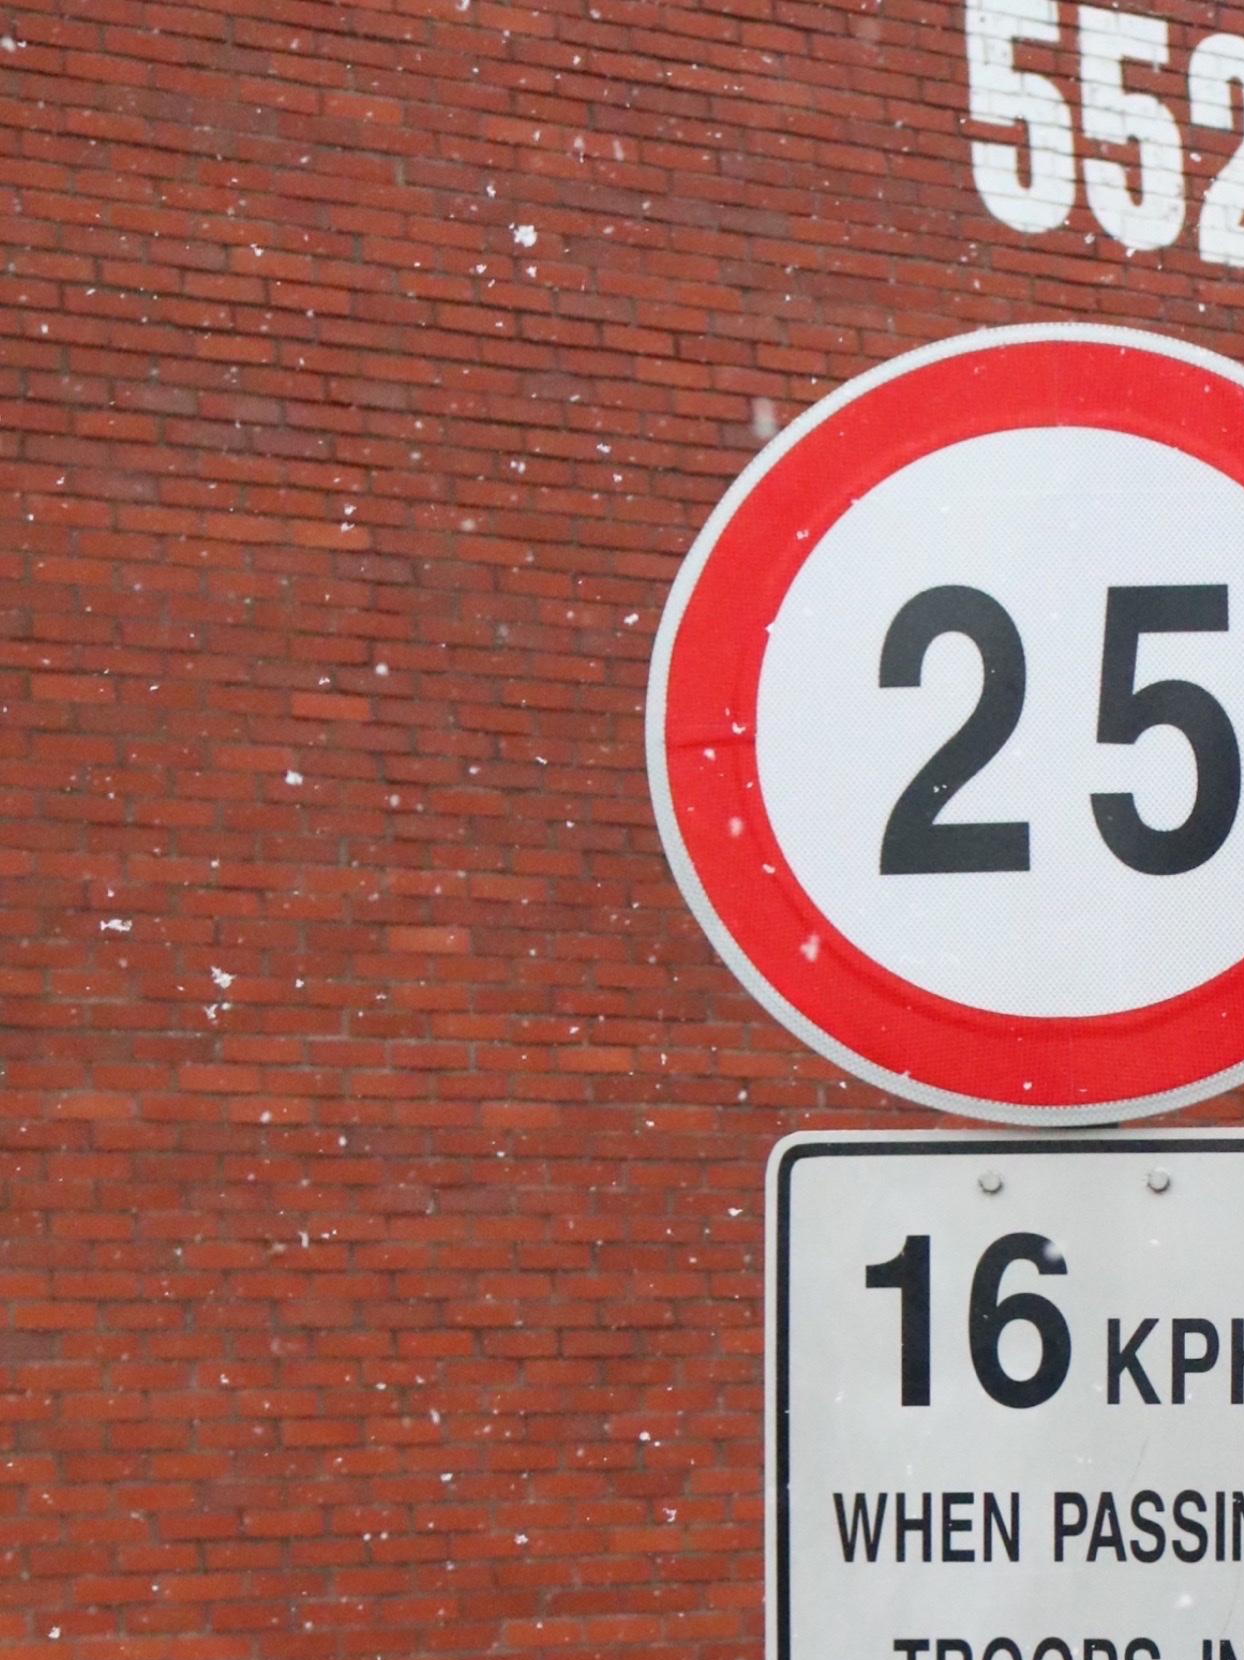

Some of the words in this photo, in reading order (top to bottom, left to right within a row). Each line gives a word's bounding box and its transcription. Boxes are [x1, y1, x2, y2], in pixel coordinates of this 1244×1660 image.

[879, 584, 1241, 876] 25
[865, 1232, 1072, 1409] 16
[833, 1491, 1021, 1563] WHEN
